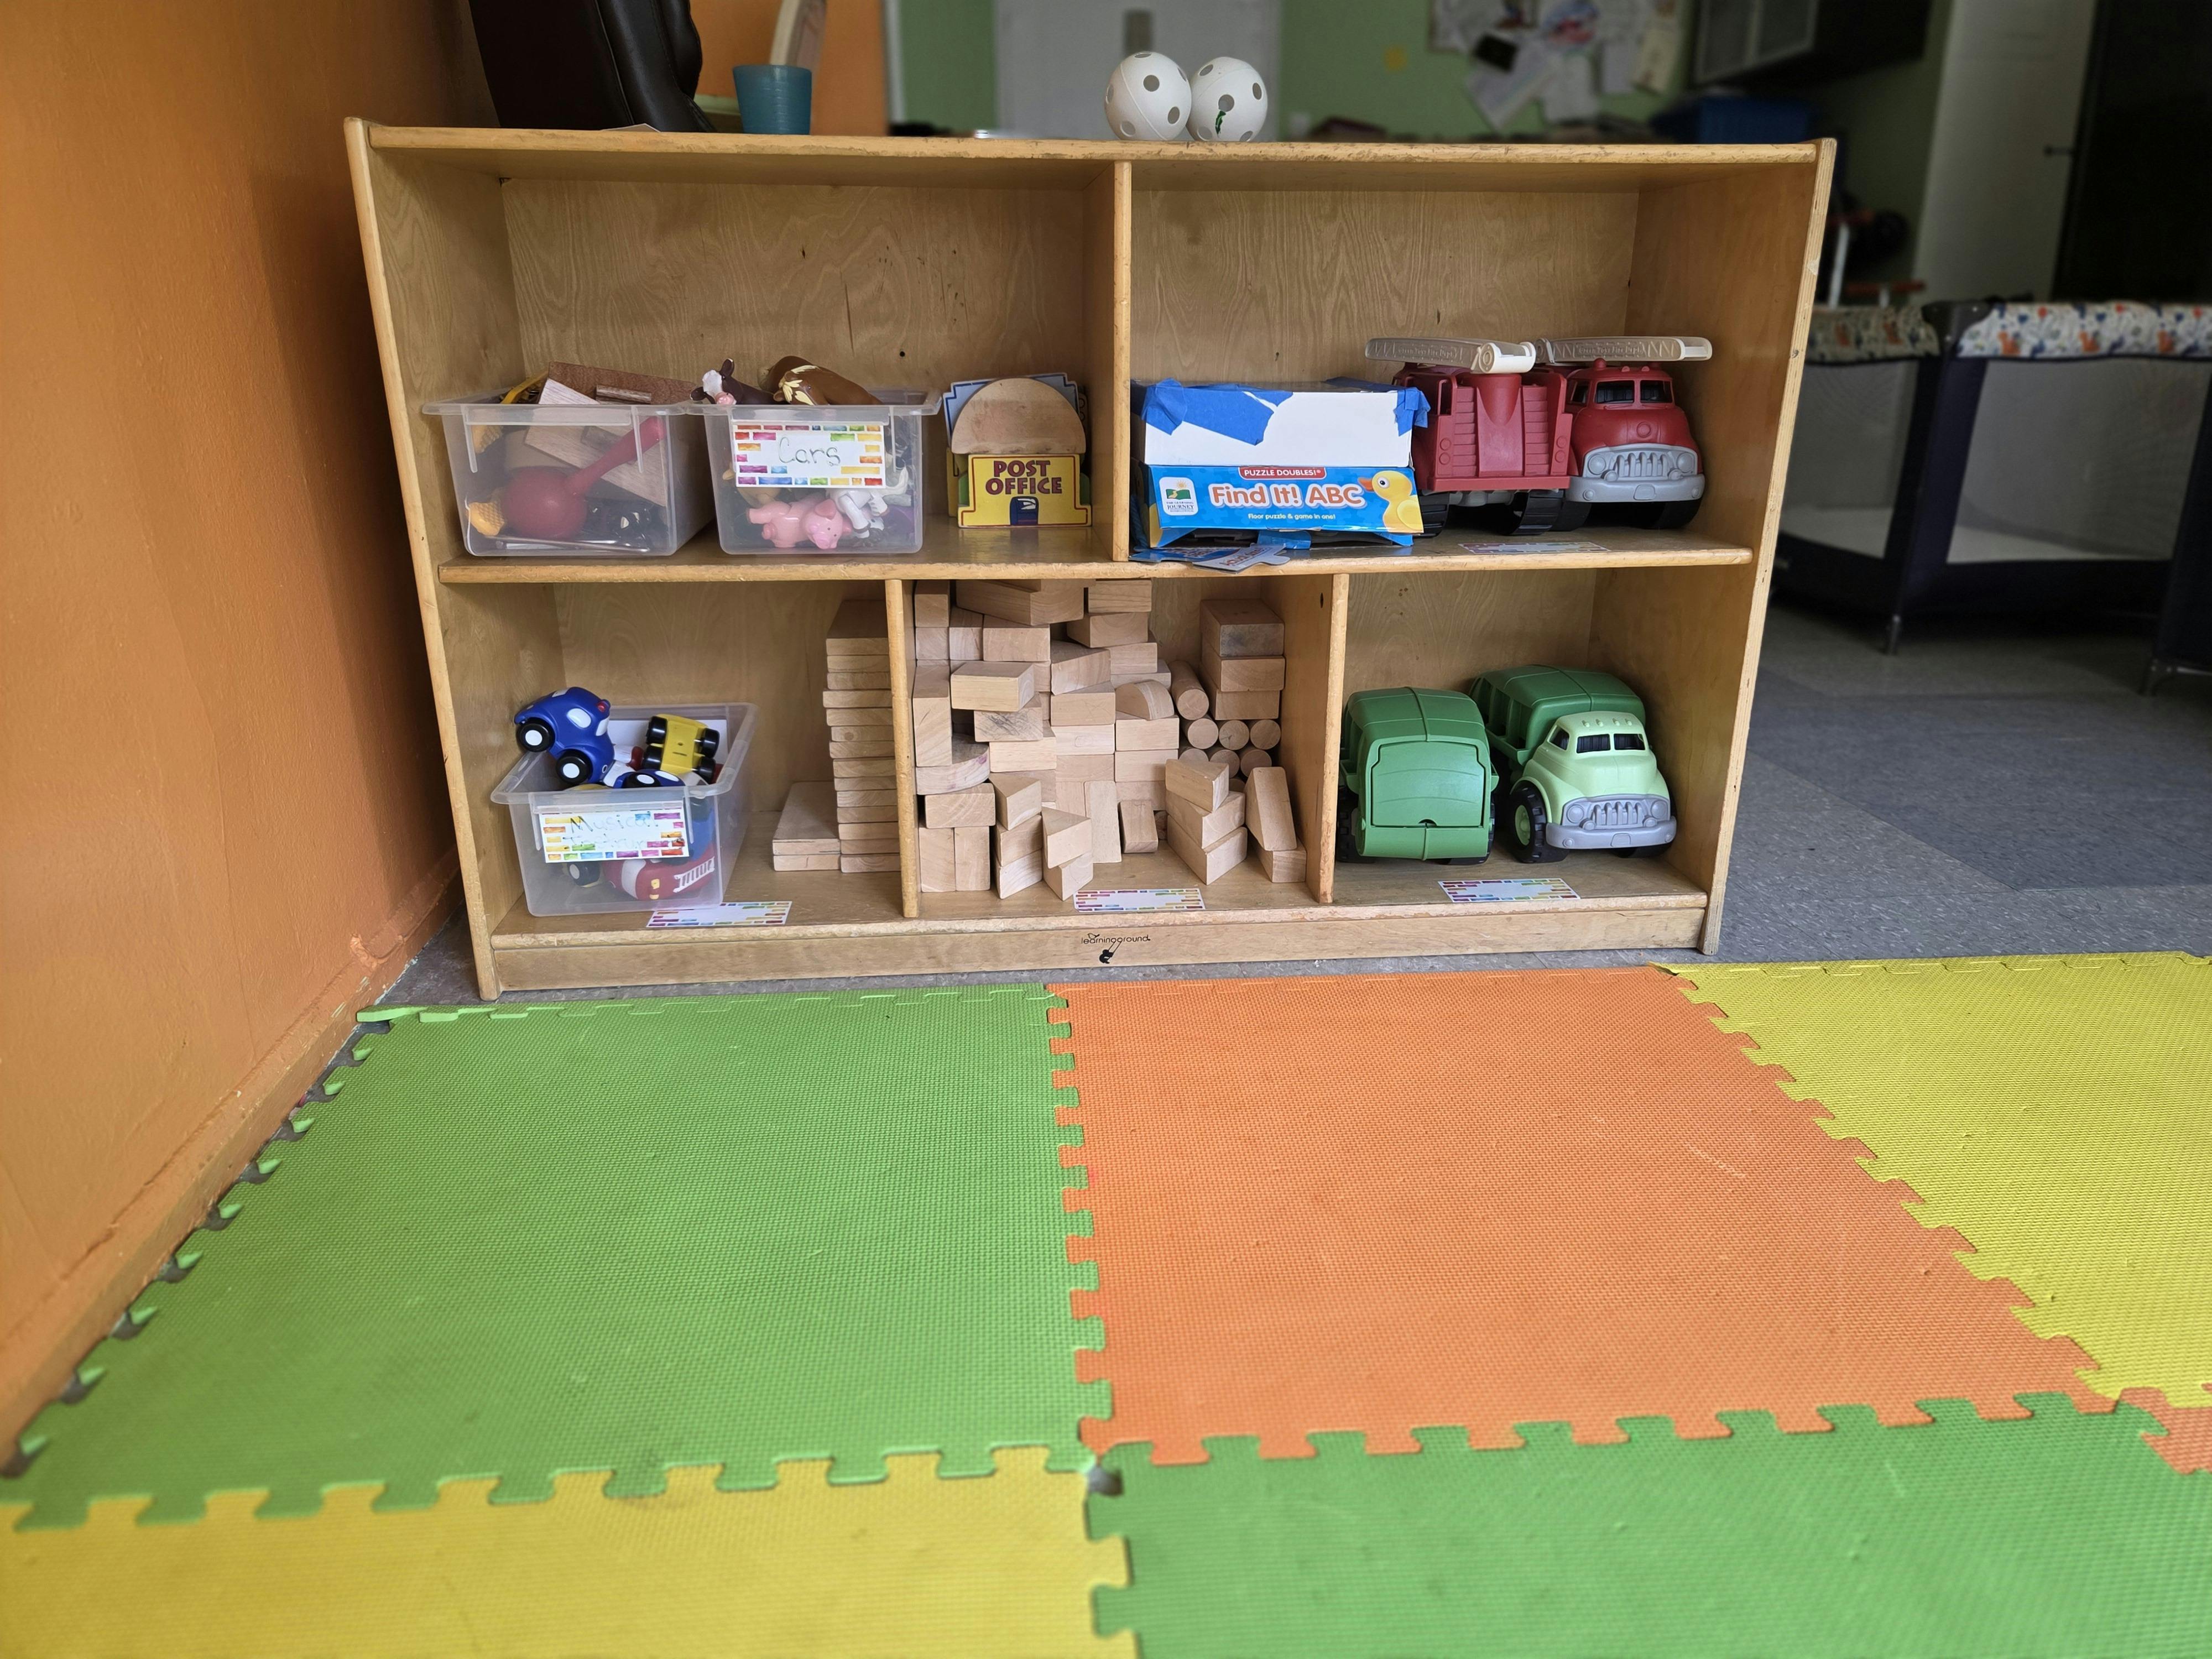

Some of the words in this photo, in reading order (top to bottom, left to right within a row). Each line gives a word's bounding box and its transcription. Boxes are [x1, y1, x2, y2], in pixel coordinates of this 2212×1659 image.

[778, 436, 841, 467] Cars
[994, 460, 1050, 477] POST
[985, 477, 1062, 495] OFFICE
[1211, 486, 1267, 504] Find
[1273, 486, 1300, 504] It!
[1308, 486, 1362, 504] ABC
[570, 811, 659, 833] Musical
